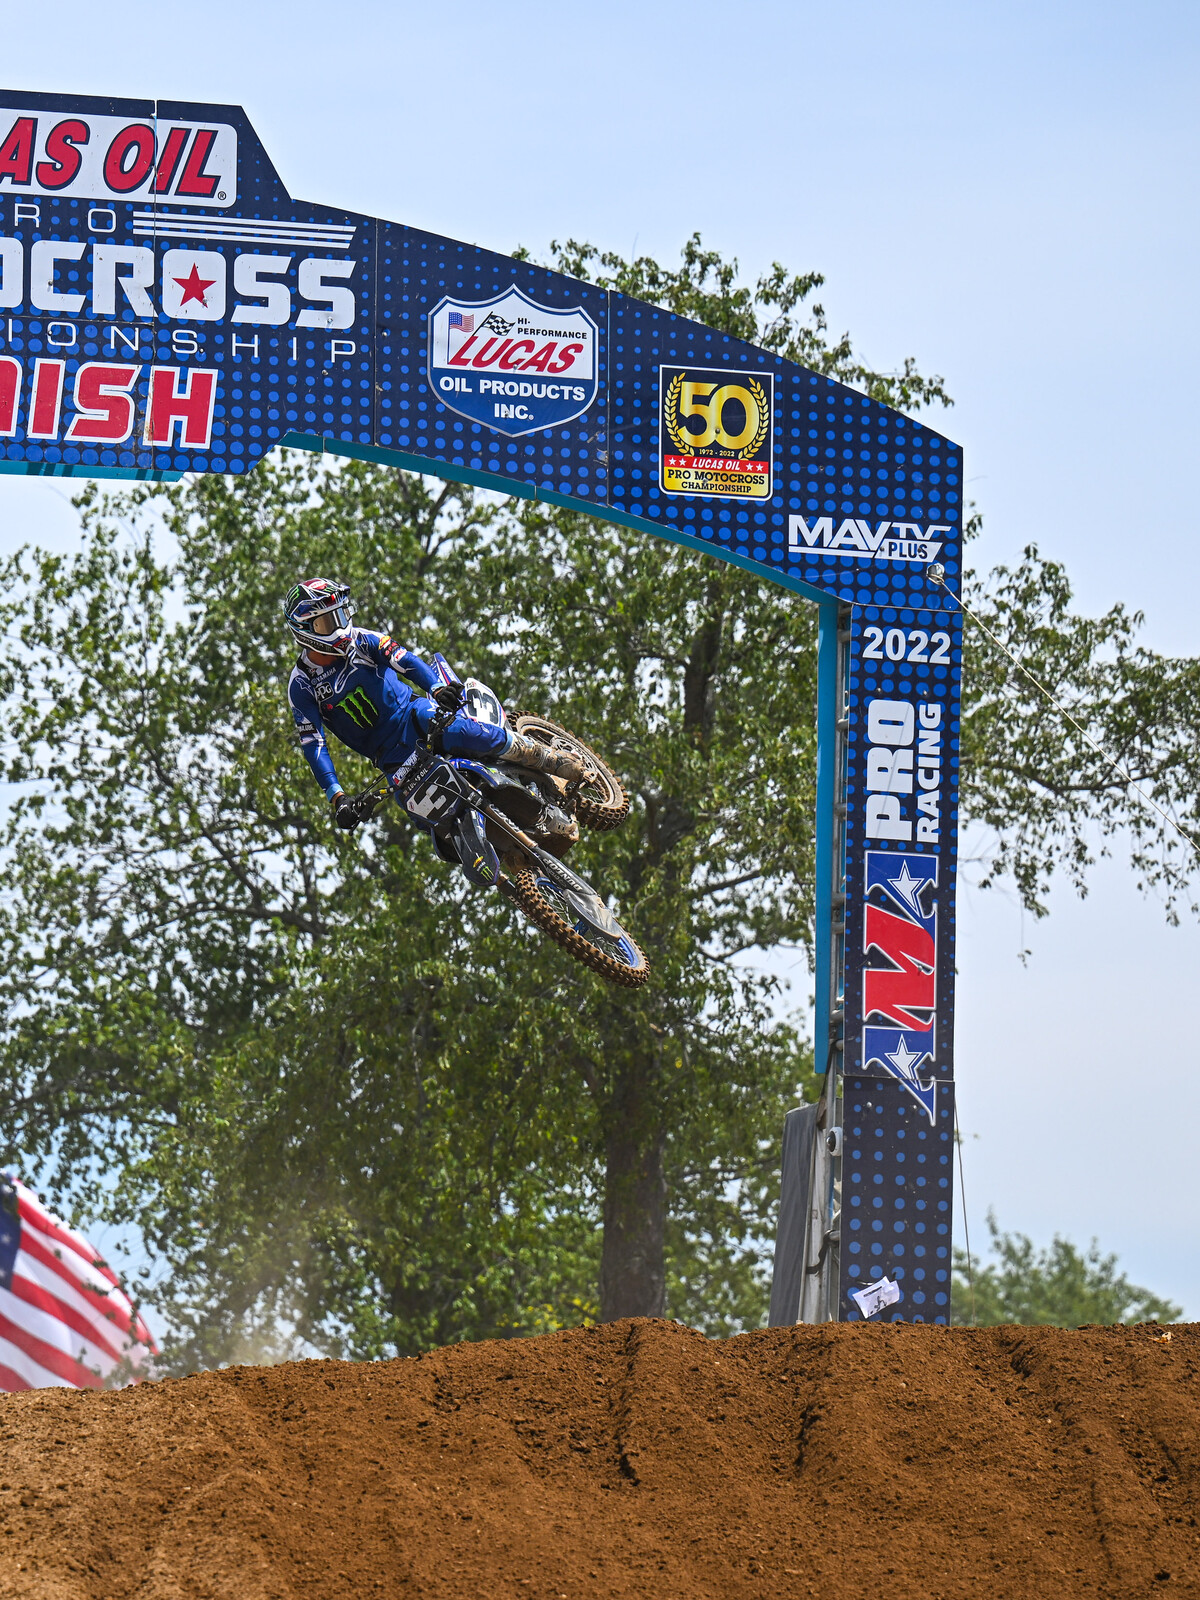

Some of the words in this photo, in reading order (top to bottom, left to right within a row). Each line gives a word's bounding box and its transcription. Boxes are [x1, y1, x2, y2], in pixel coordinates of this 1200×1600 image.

[102, 122, 222, 198] OIL
[517, 327, 588, 340] PERFORMANCE
[448, 335, 584, 374] LUCAS
[439, 376, 473, 393] OIL
[479, 379, 586, 401] PRODUCTS
[676, 381, 760, 450] 50
[692, 457, 724, 469] LUCAS
[725, 460, 741, 471] OIL
[699, 448, 714, 456] 1972
[719, 449, 735, 457] 2022
[667, 468, 691, 479] PRO
[694, 470, 765, 485] MOTOCROSS
[681, 481, 752, 494] CHAMPIONSHIP
[788, 514, 952, 551] MAVTV
[888, 541, 928, 560] PLUS
[862, 626, 951, 665] 2022
[316, 667, 337, 682] YAMAHA
[865, 698, 916, 841] PRO
[916, 703, 942, 844] RACING
[412, 765, 460, 820] 3
[542, 858, 583, 891] DUNLOP
[862, 849, 940, 1128] AMA
